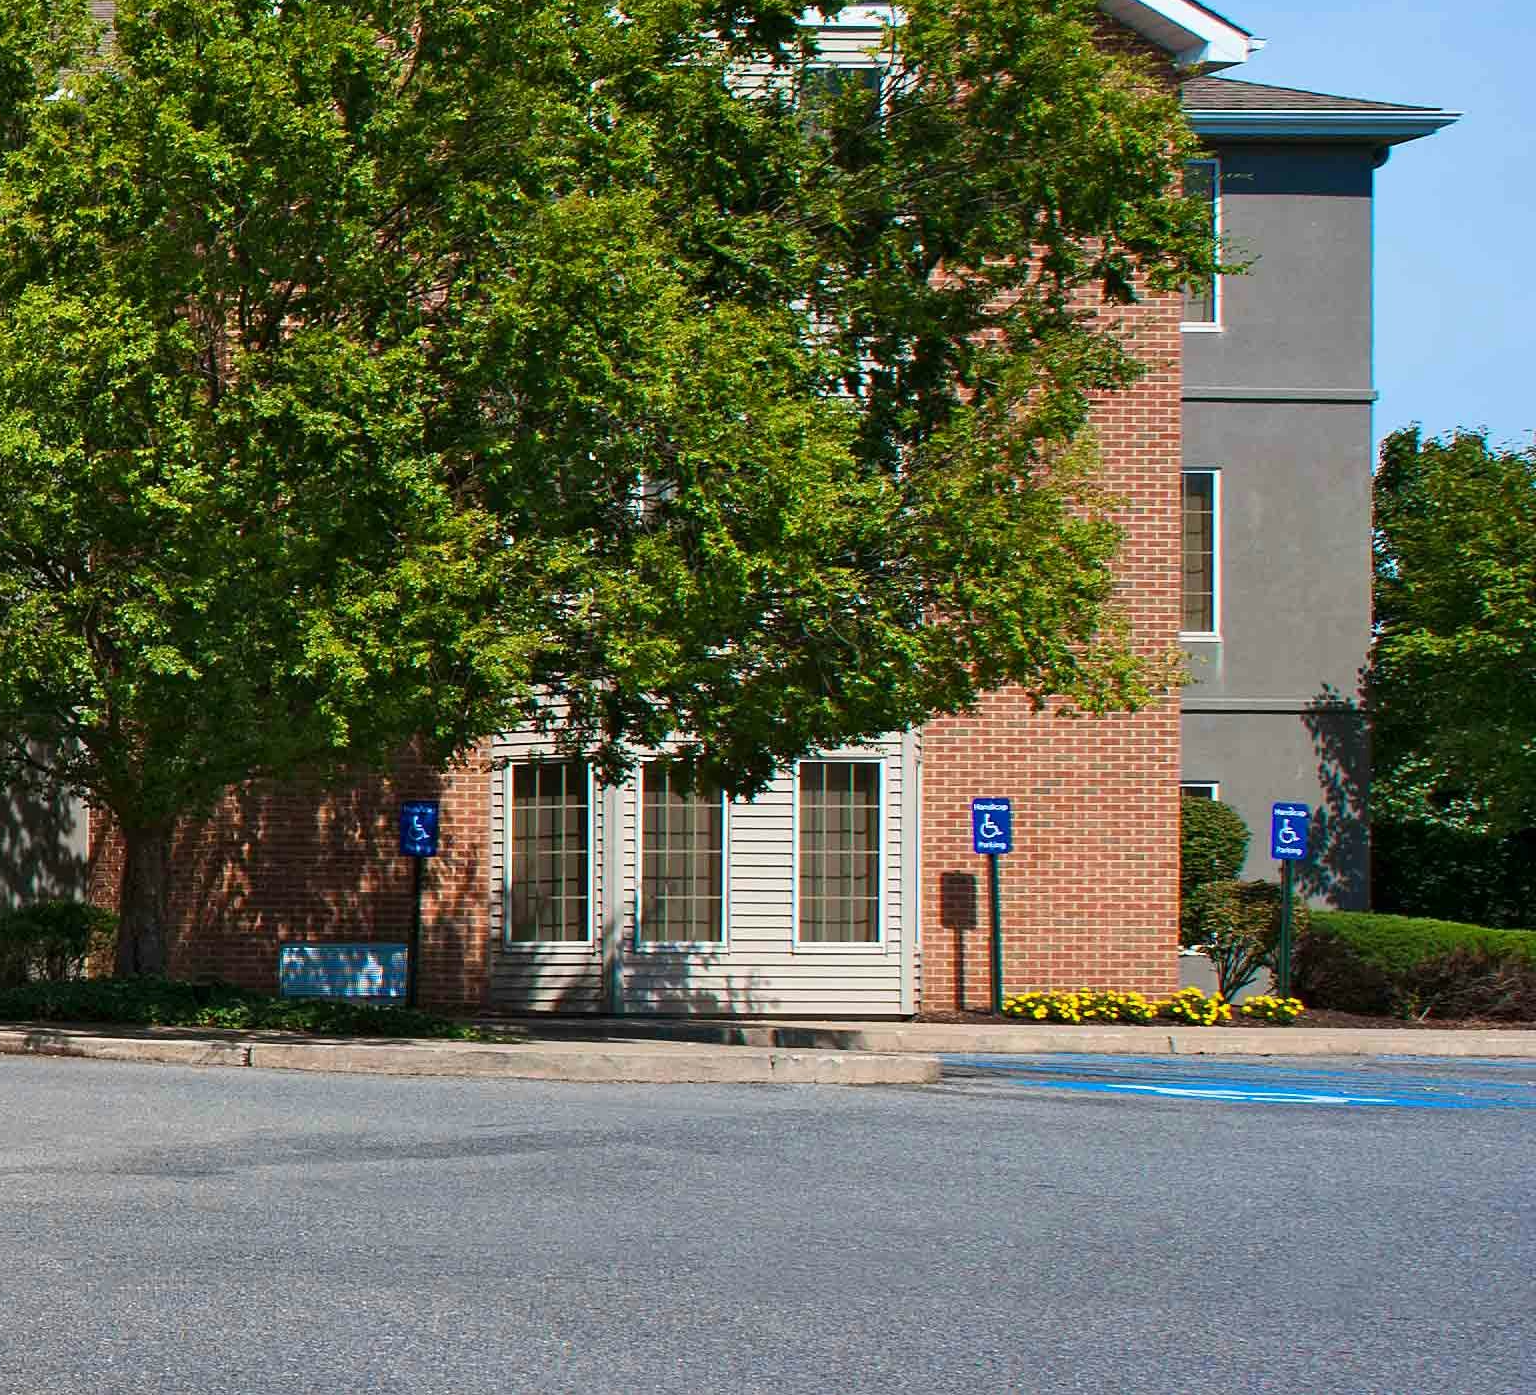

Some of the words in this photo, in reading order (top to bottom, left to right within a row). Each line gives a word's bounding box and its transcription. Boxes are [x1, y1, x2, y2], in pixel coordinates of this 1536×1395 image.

[973, 803, 1009, 812] Handicap
[977, 841, 1007, 850] Parking
[1275, 846, 1303, 856] Parking
